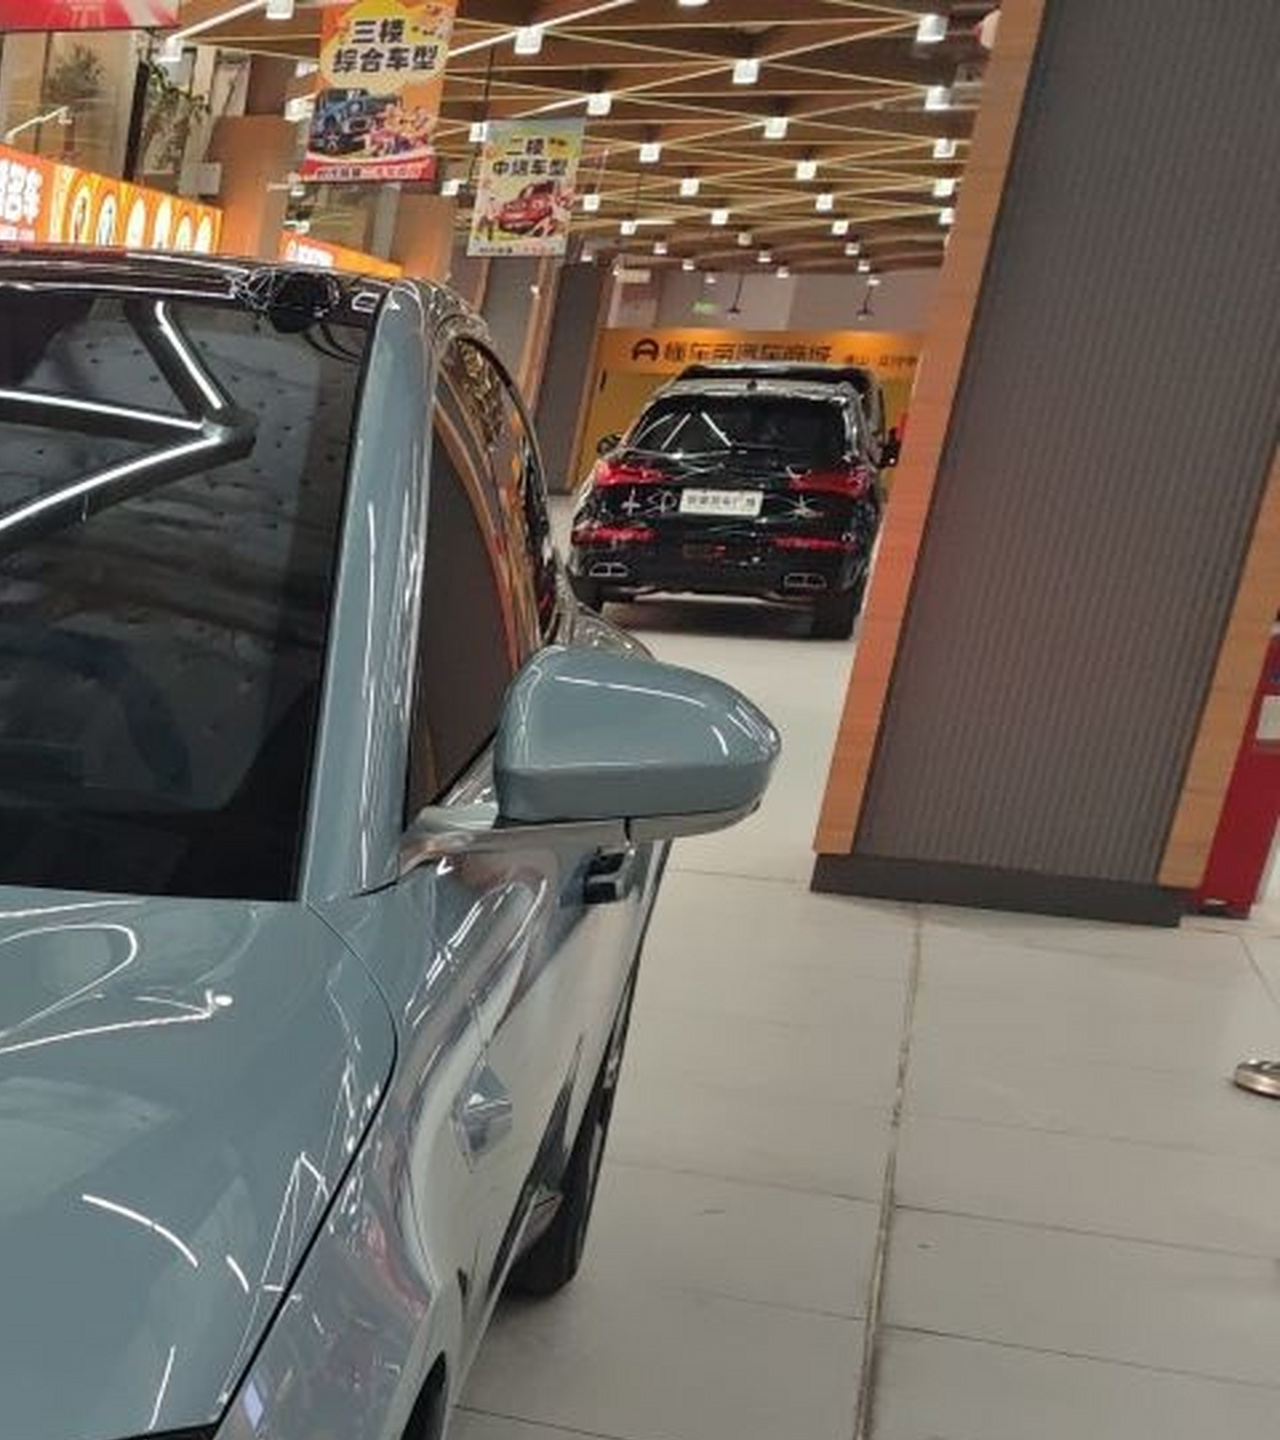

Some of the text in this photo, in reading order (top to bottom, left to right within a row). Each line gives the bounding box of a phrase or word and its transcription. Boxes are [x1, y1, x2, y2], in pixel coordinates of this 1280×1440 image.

[352, 19, 404, 43] 三楼
[332, 45, 438, 73] 综合车型
